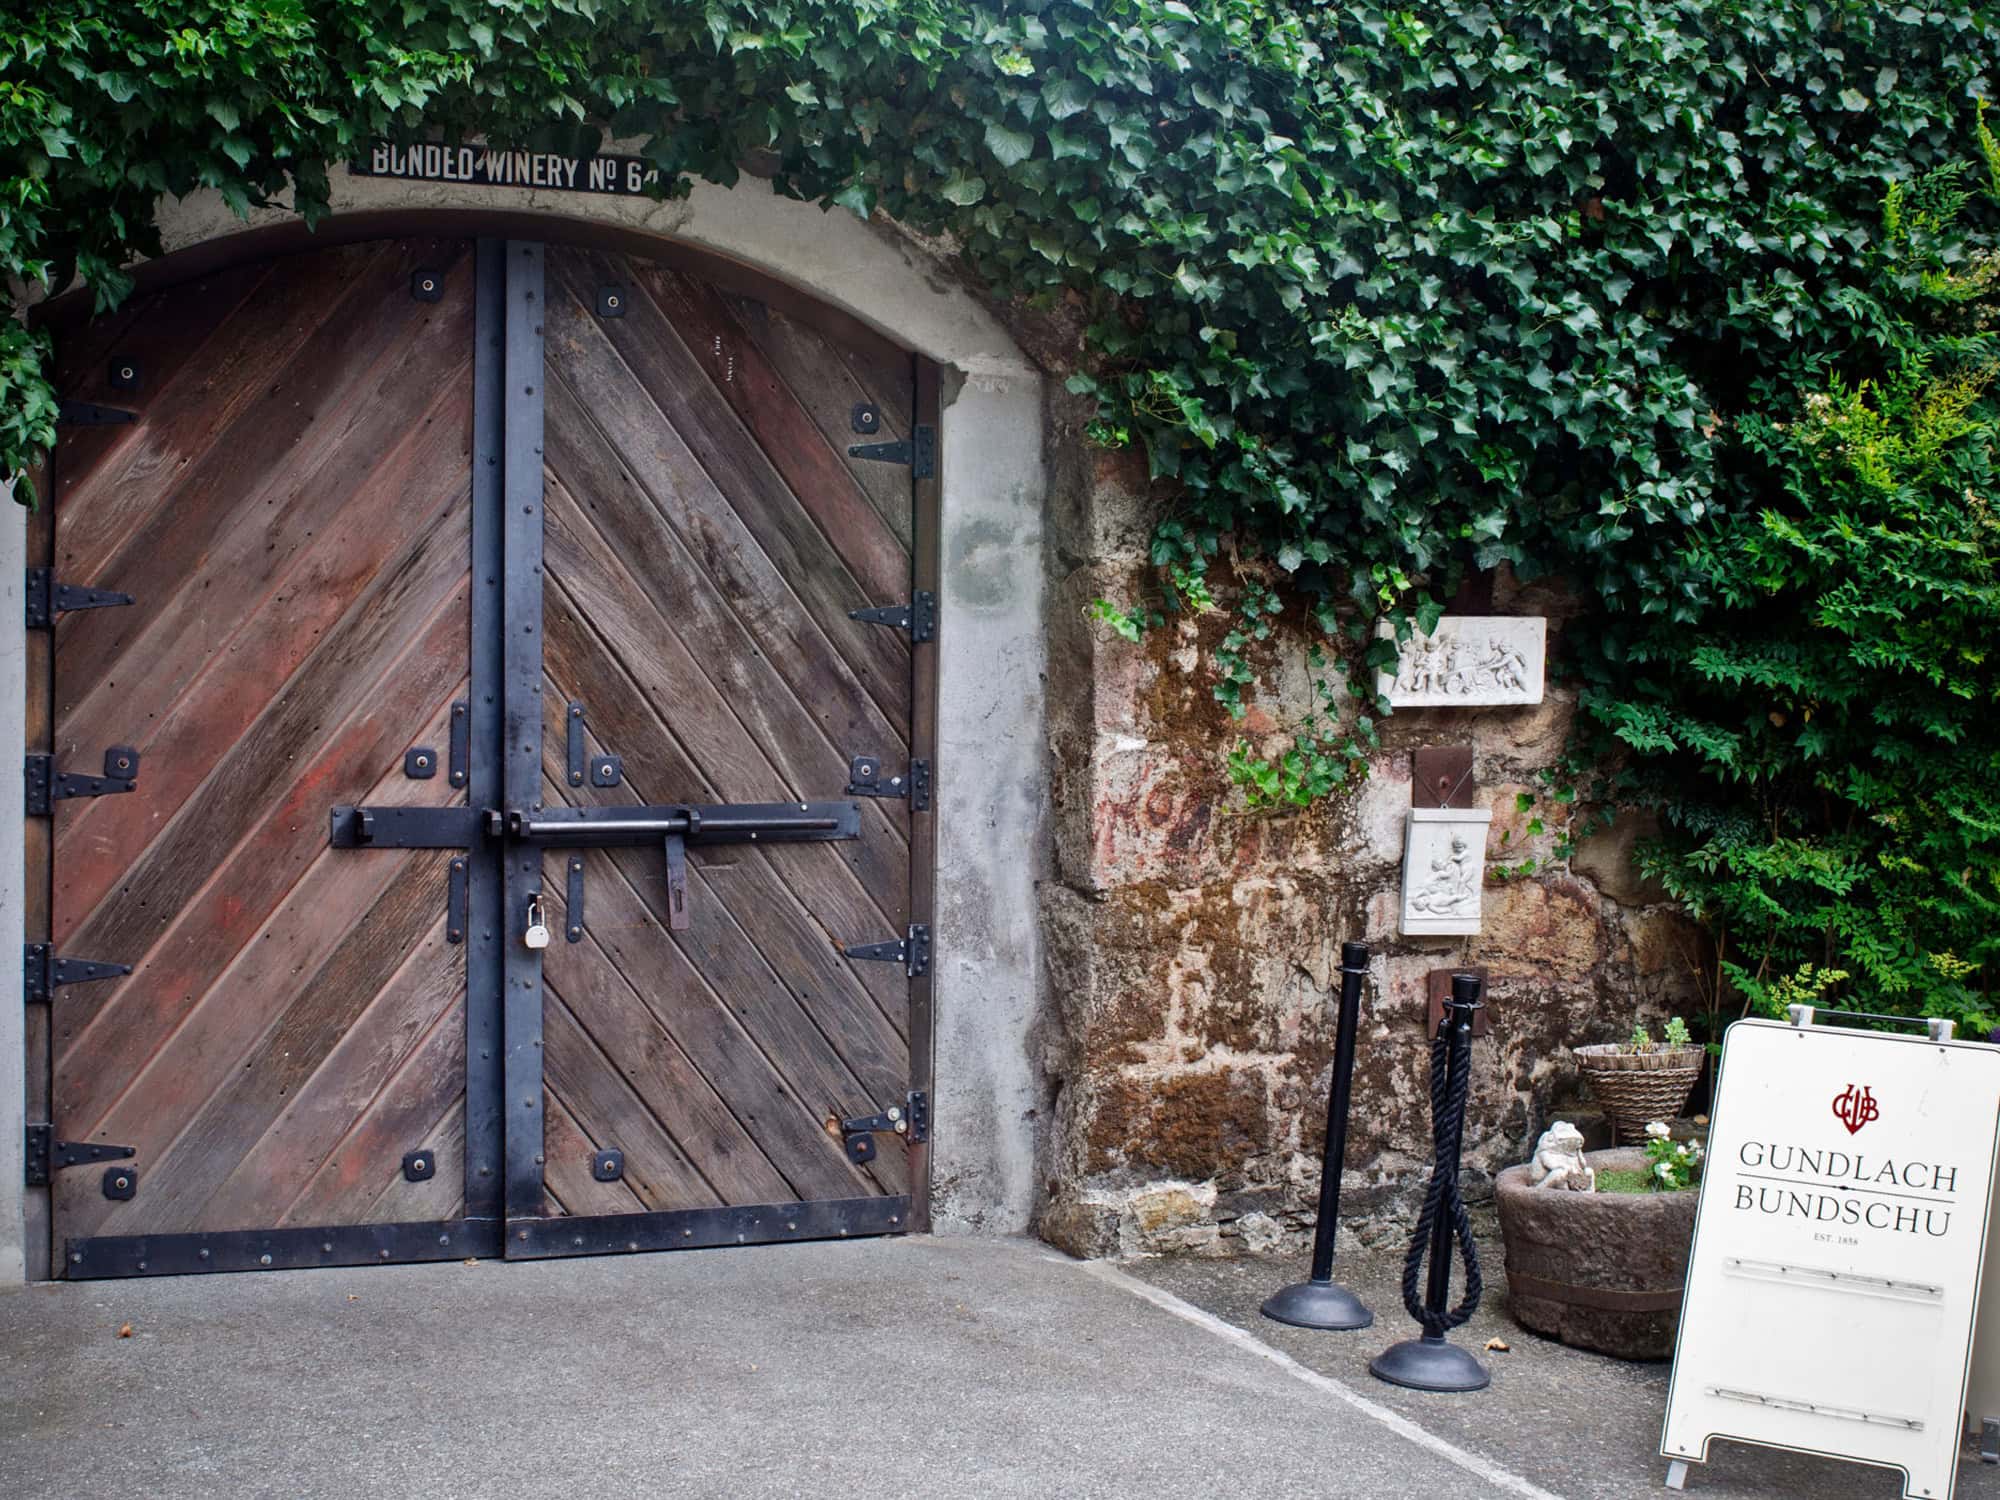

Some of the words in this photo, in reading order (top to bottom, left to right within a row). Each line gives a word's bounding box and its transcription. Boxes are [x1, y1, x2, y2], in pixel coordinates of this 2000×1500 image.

[373, 143, 473, 180] BONDED
[486, 150, 579, 188] WINERY
[1739, 1141, 1958, 1192] GUNDLACH
[1734, 1184, 1951, 1236] BUNDSCHU
